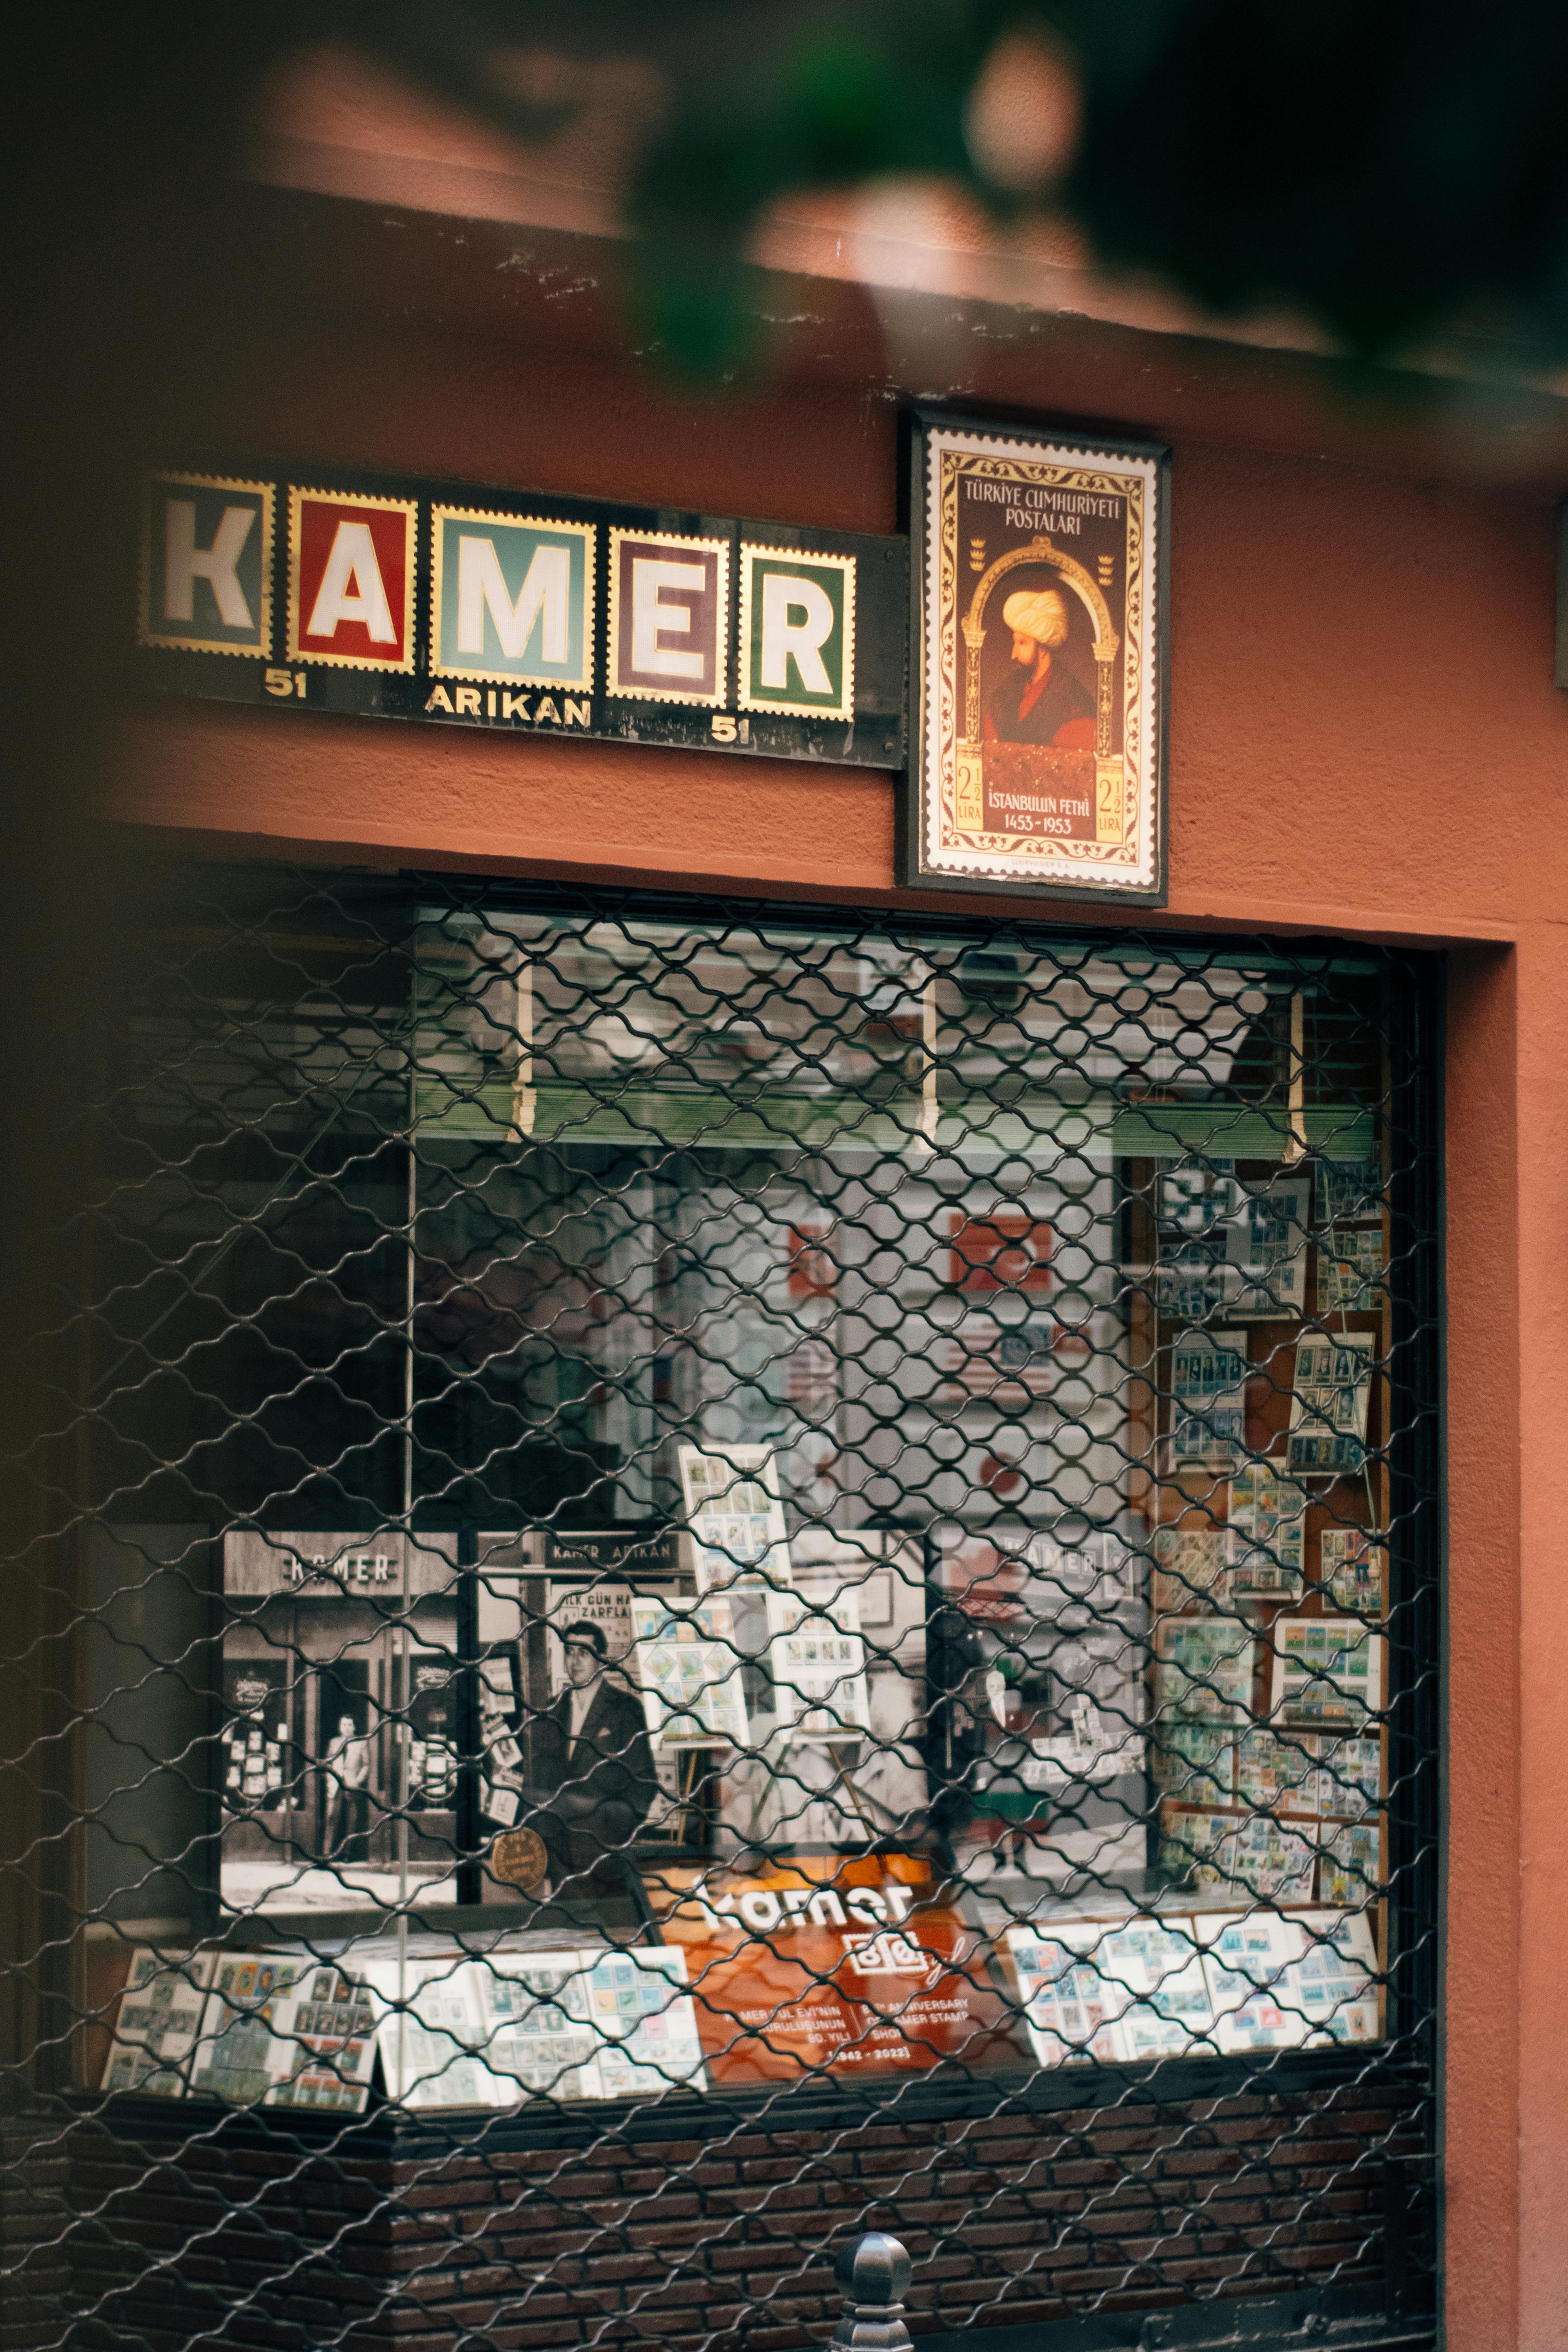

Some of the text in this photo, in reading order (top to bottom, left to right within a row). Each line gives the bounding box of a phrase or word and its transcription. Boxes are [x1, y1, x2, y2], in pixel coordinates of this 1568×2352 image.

[965, 479, 1119, 519] TÜRKİYE CUMHURİYETİ
[1006, 508, 1080, 535] POSTALARI
[165, 500, 834, 694] KAMER
[264, 668, 307, 698] 51
[424, 685, 591, 728] ARIKAN
[959, 802, 981, 819] LİRA
[988, 788, 1090, 817] İSTANBULUN FETHİ
[1099, 815, 1121, 831] LİRA
[587, 1592, 611, 1605] GÜN
[693, 1875, 913, 1930] kamer
[724, 2009, 768, 2021] KMER
[771, 2008, 794, 2018] UL
[930, 2011, 970, 2023] STAMP
